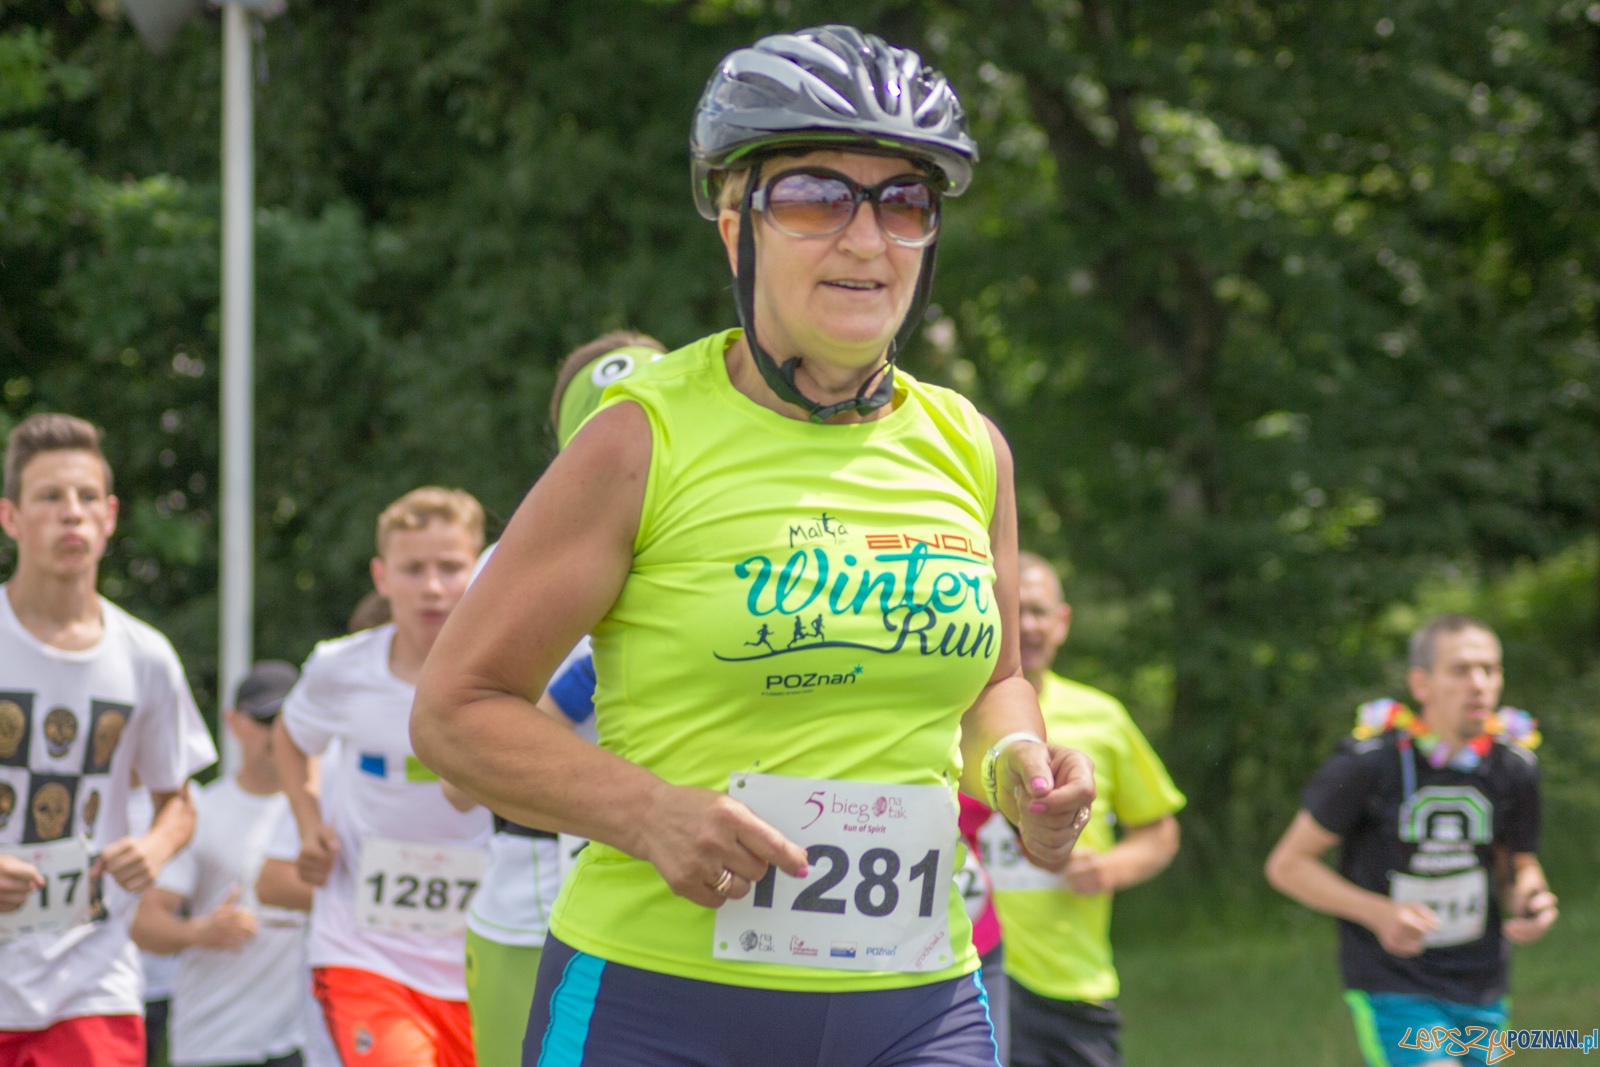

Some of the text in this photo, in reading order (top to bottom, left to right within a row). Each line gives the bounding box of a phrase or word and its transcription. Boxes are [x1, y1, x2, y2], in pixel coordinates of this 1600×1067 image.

[790, 513, 848, 548] Malta
[734, 542, 989, 616] Winter
[883, 604, 994, 658] Run
[801, 791, 870, 830] 5 bieg
[868, 825, 886, 834] Spirit
[367, 871, 479, 911] 1287
